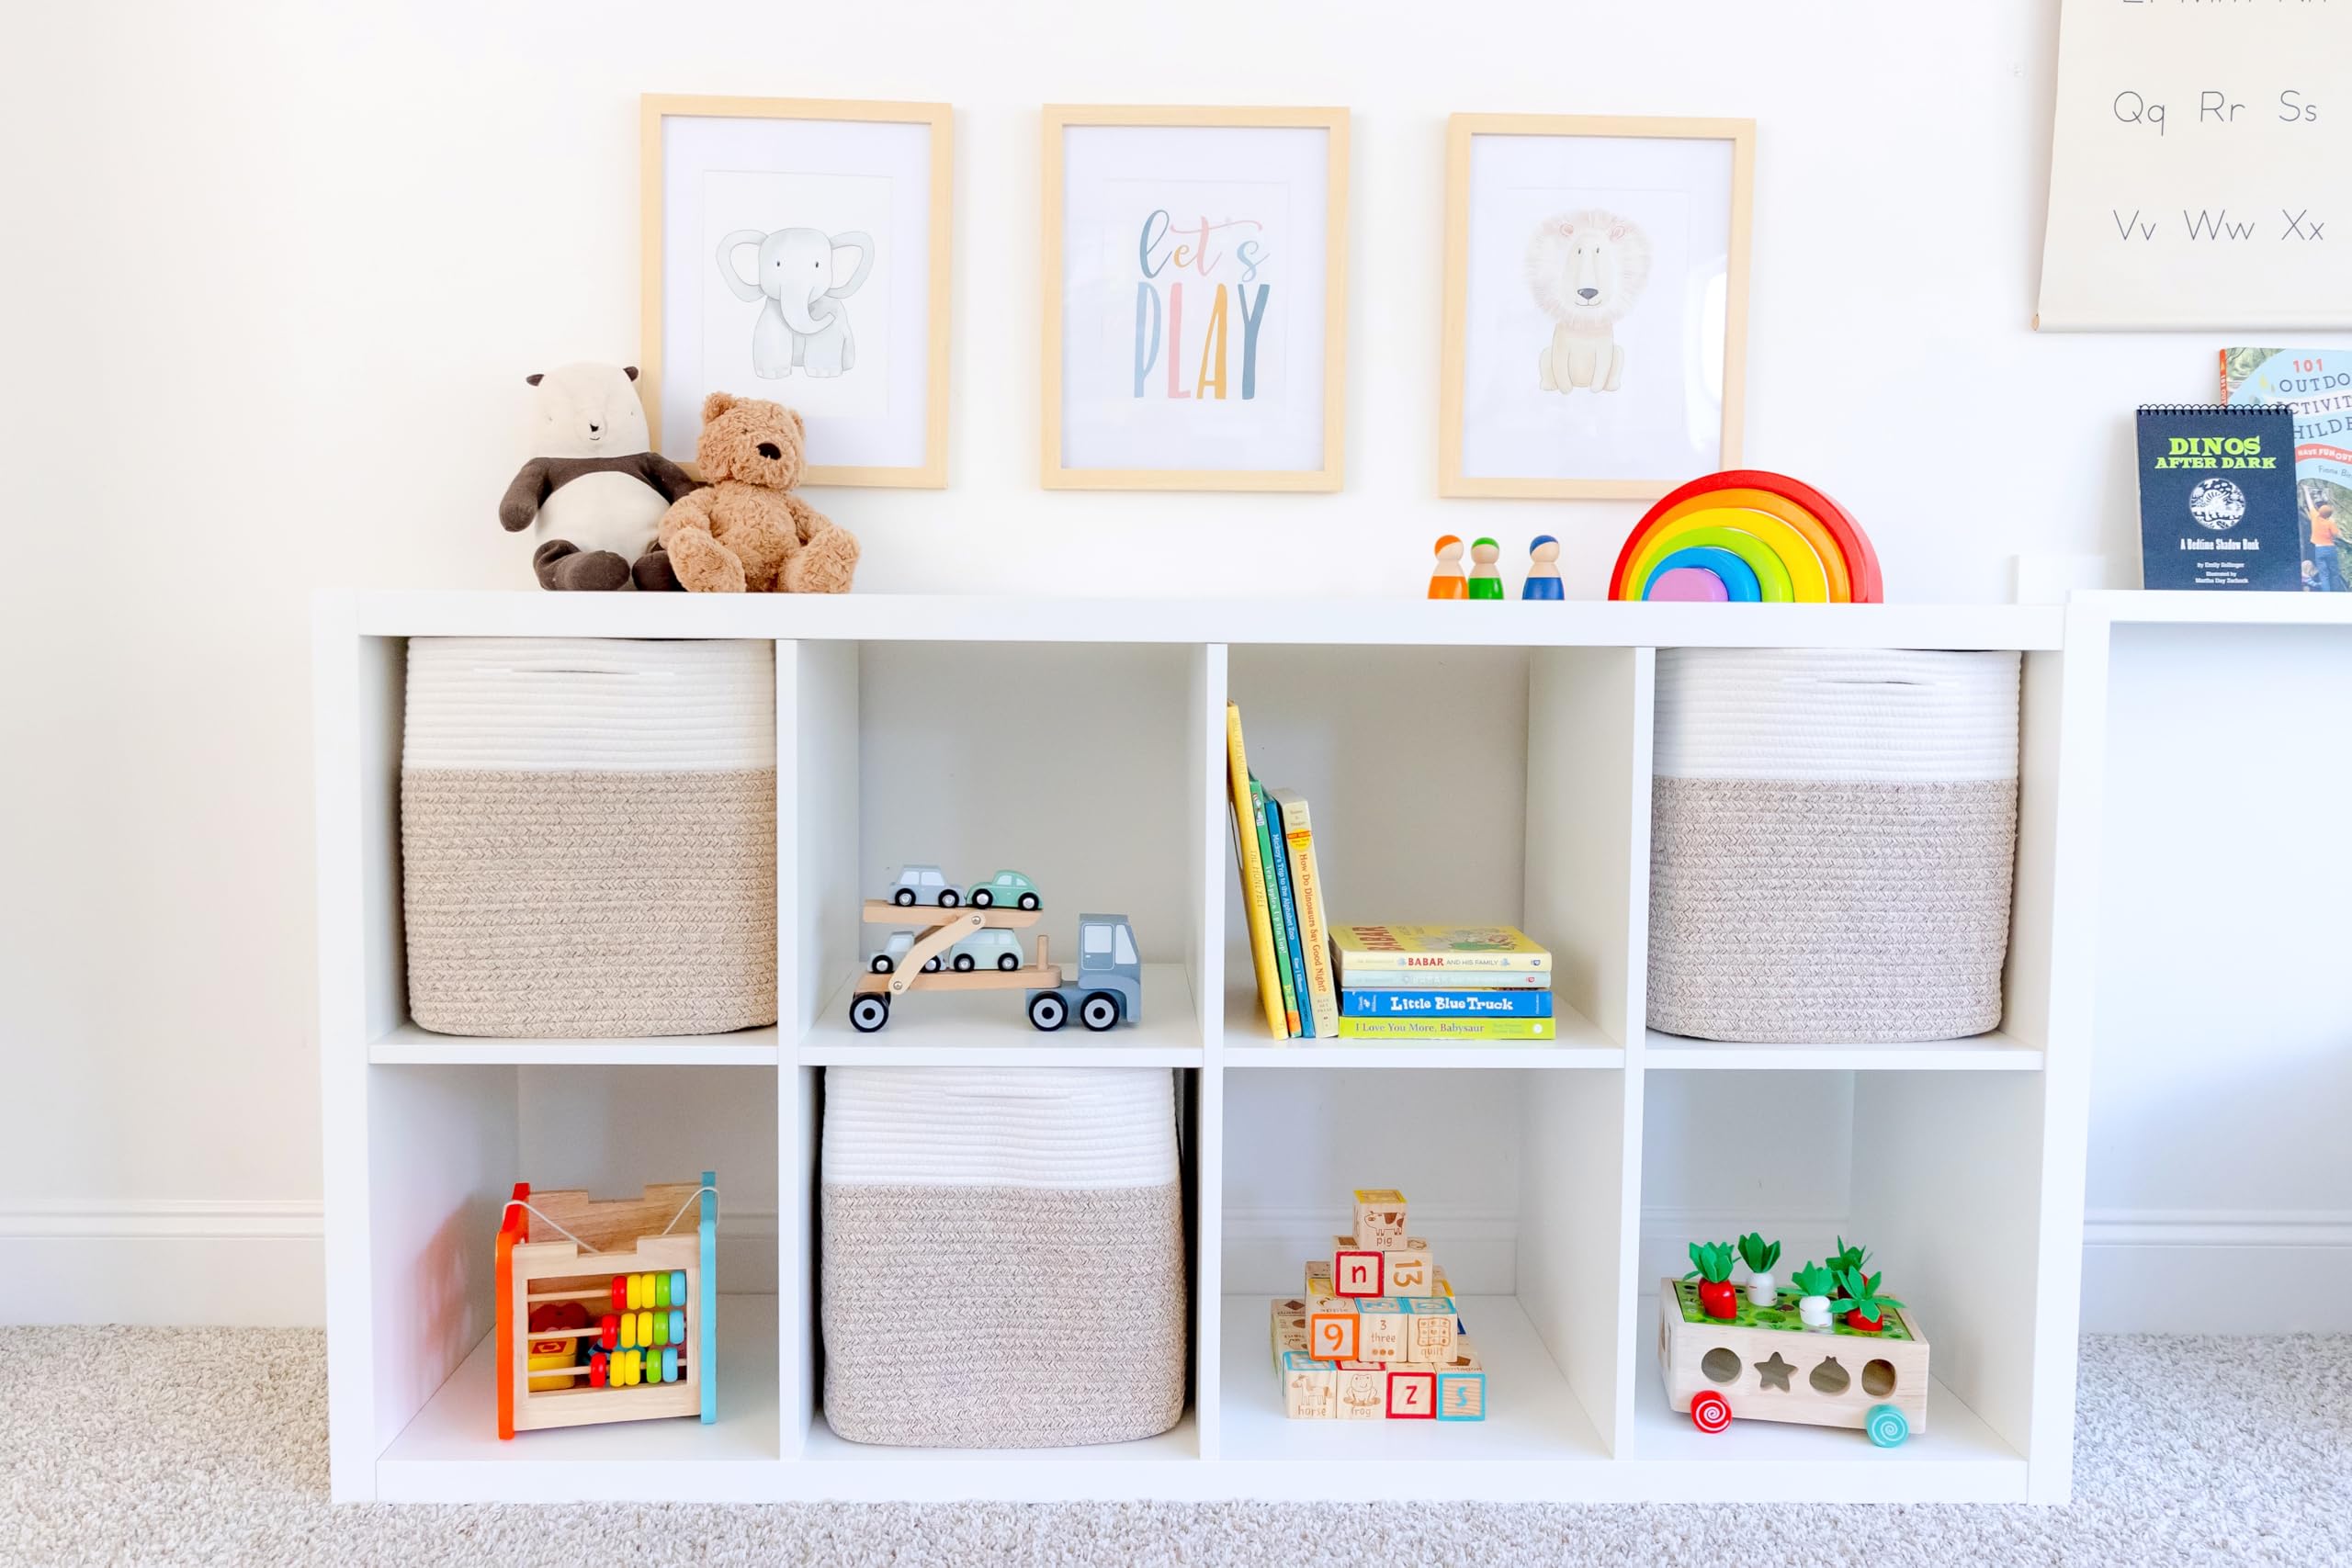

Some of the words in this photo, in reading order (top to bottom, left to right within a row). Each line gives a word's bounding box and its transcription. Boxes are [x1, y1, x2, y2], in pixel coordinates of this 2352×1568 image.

[2113, 90, 2165, 137] Qq
[2199, 90, 2246, 122] Rr
[2278, 89, 2317, 122] Ss
[2112, 209, 2157, 241] Vv
[2183, 209, 2256, 241] Ww
[2280, 209, 2325, 241] Xx
[1134, 281, 1271, 400] PLAY
[2293, 358, 2324, 374] 101
[2168, 435, 2261, 457] DINOS
[2154, 457, 2218, 469] AFTER
[2222, 457, 2277, 469] DARK
[2180, 538, 2187, 550] A
[2187, 538, 2214, 550] Bedtime
[2215, 538, 2242, 550] Shadow
[1299, 853, 1308, 872] How
[1302, 874, 1311, 886] Do
[1268, 881, 1277, 909] Apples
[1283, 897, 1295, 928] Alphabet
[1305, 887, 1316, 928] Dinosaurs
[1310, 929, 1318, 942] Say
[1312, 942, 1322, 966] Good
[1408, 957, 1444, 966] BABAR
[1315, 967, 1327, 992] Night?
[1390, 997, 1431, 1010] Little
[1435, 997, 1466, 1010] Blue
[1466, 997, 1513, 1010] Truck
[1356, 1023, 1360, 1032] I
[1363, 1023, 1385, 1032] Love
[1388, 1023, 1406, 1032] You
[1409, 1023, 1437, 1033] More,
[1441, 1023, 1485, 1033] Babysaur
[1376, 1236, 1392, 1247] pig
[1351, 1266, 1366, 1283] n
[1393, 1259, 1423, 1287] 13
[1379, 1319, 1387, 1330] 3
[1324, 1324, 1344, 1351] 9
[1371, 1332, 1396, 1343] three
[1420, 1347, 1443, 1359] quilt
[1297, 1404, 1327, 1416] horse
[1351, 1406, 1371, 1417] frog
